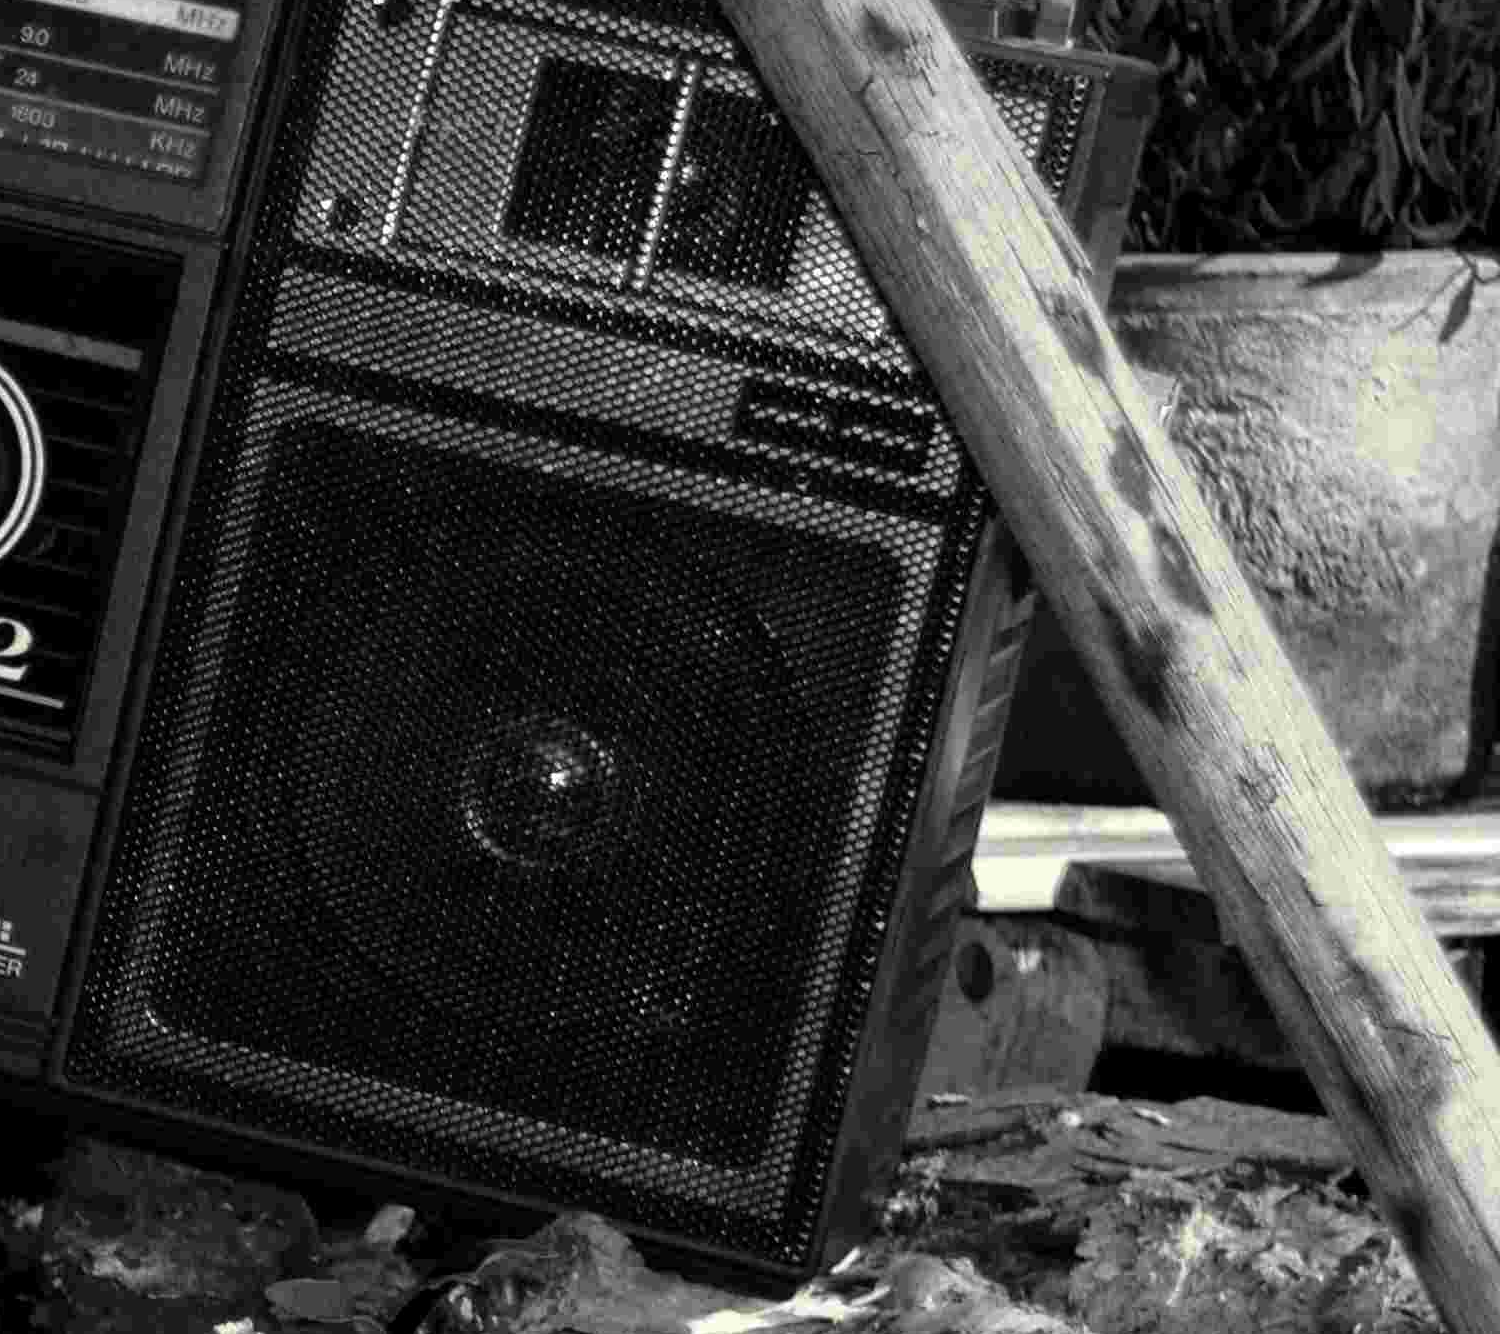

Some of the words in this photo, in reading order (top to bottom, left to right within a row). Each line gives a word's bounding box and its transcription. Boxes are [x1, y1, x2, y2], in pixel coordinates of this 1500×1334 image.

[164, 51, 216, 83] MHz
[13, 68, 40, 88] 24
[153, 93, 205, 124] MHz
[149, 130, 197, 158] KHz
